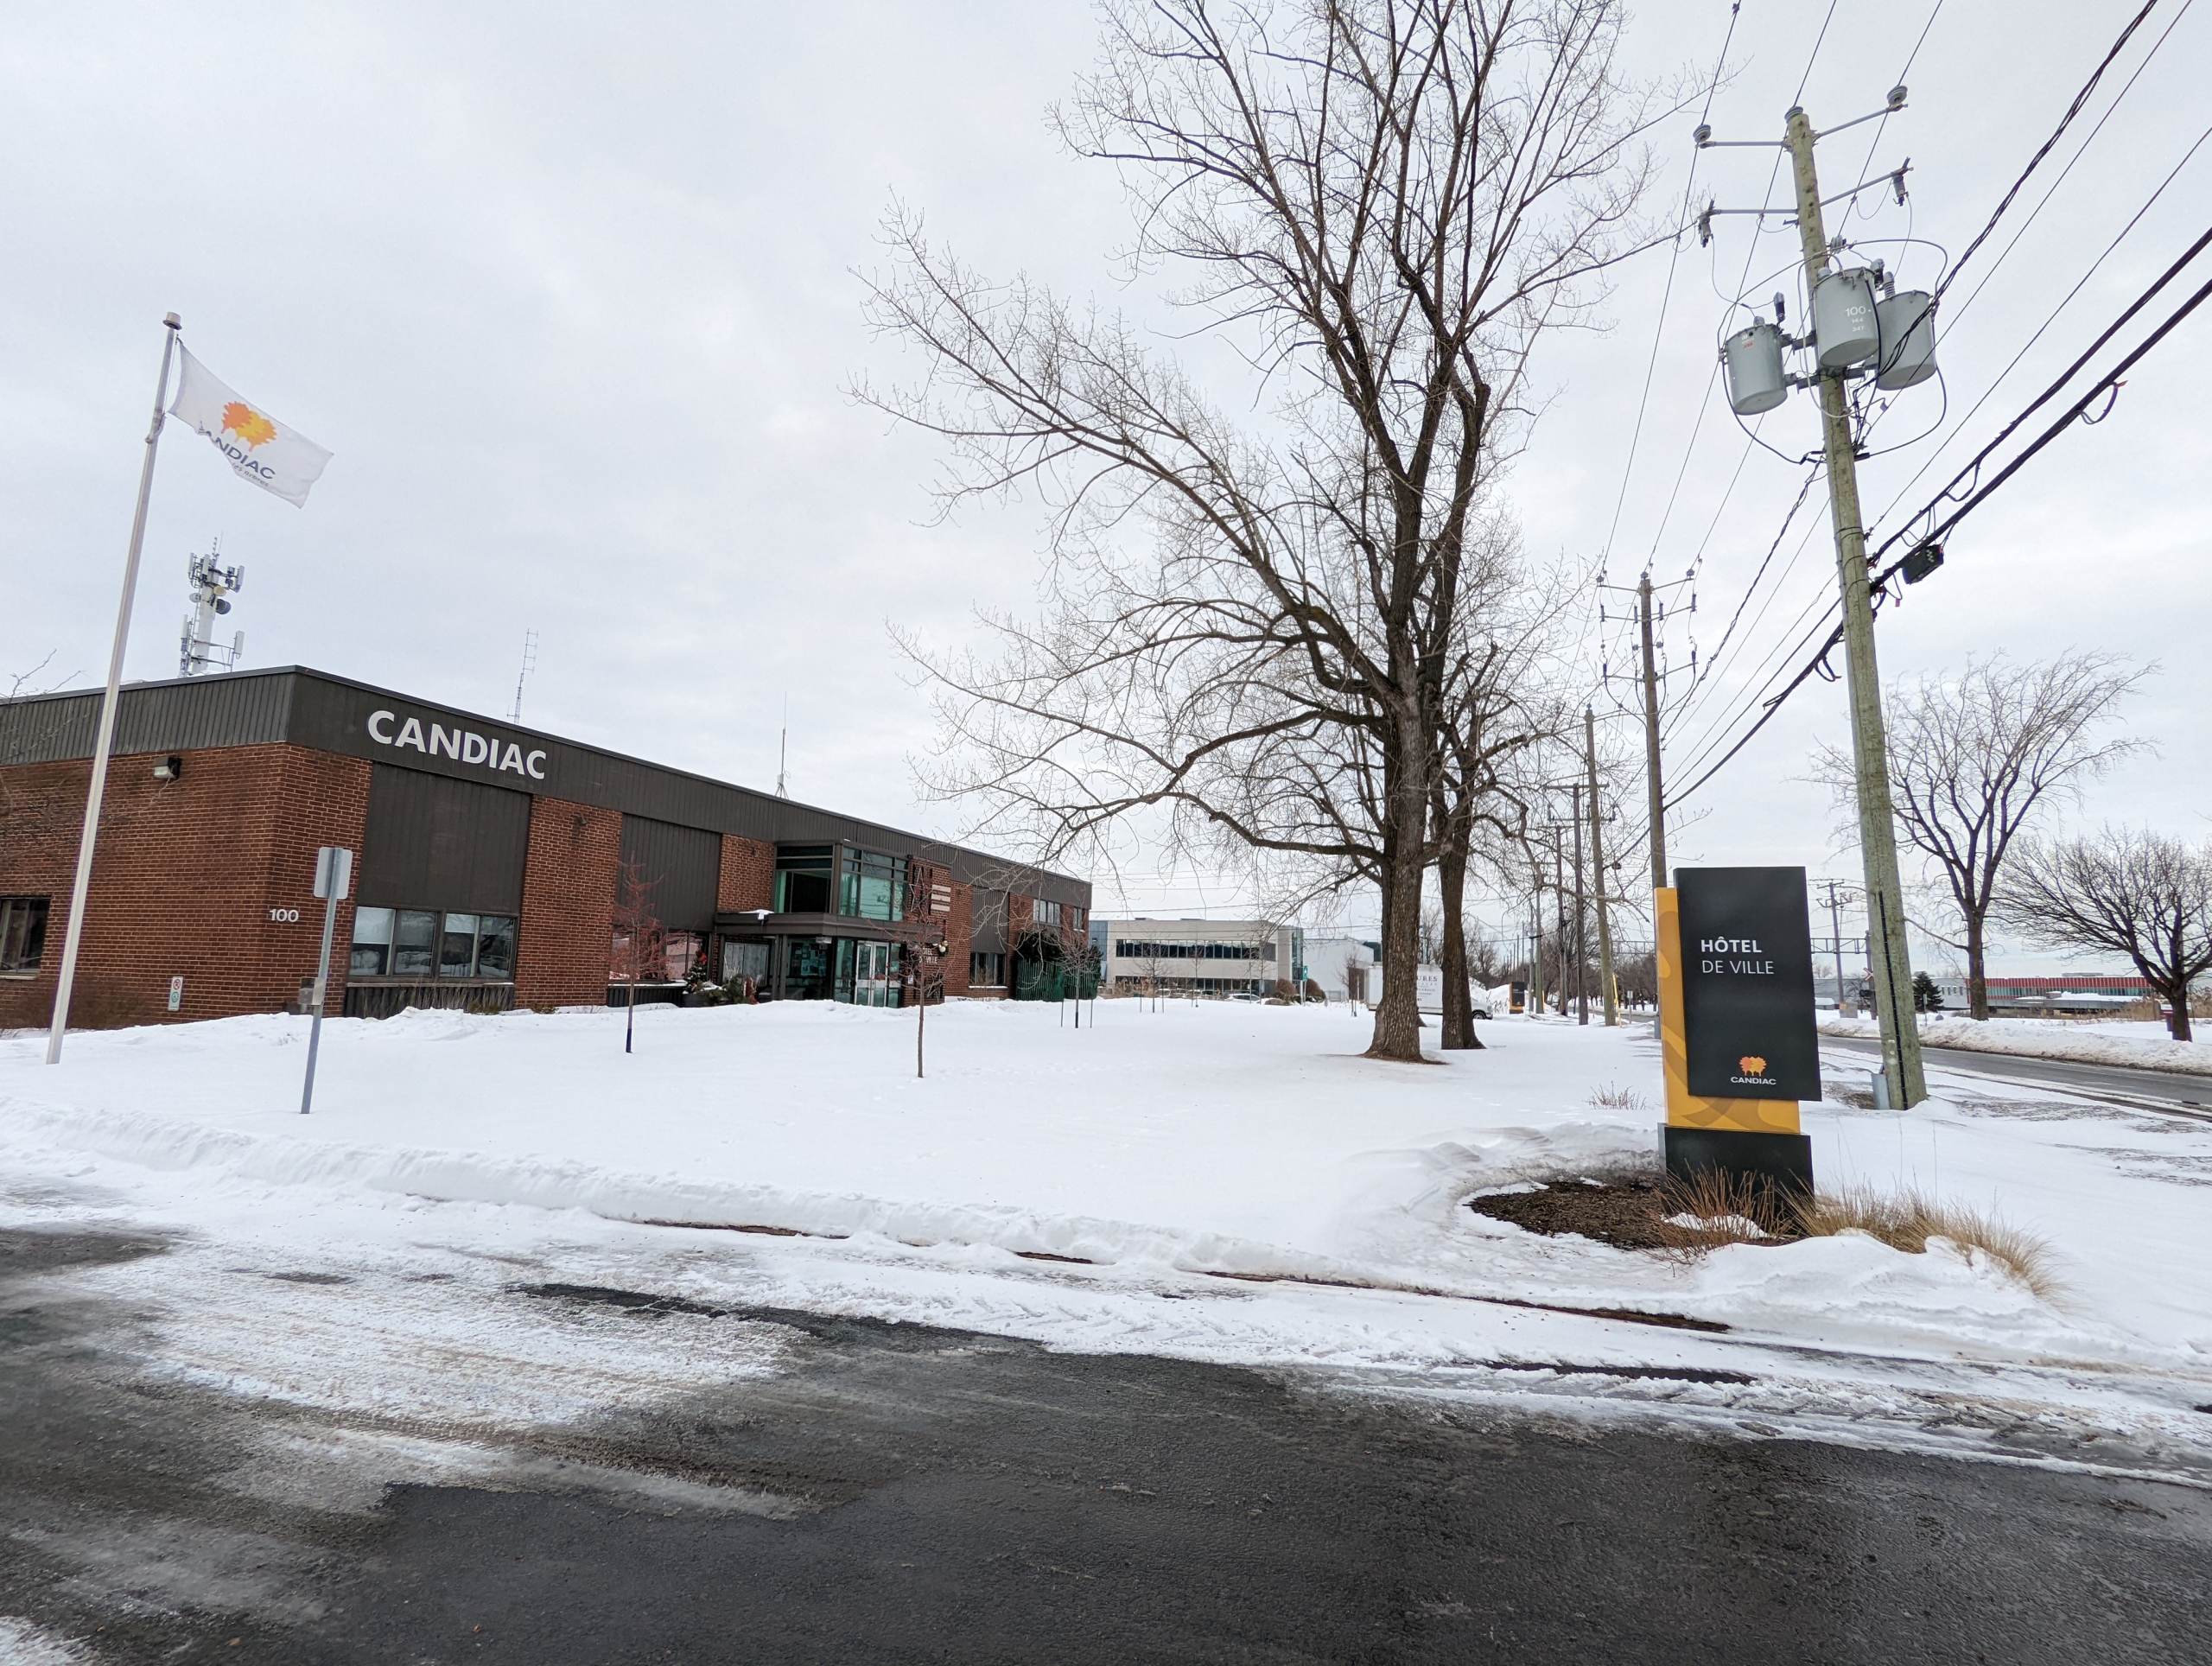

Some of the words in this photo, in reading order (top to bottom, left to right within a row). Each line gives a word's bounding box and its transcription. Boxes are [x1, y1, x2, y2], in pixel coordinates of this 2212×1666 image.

[1844, 305, 1866, 317] 100
[199, 422, 276, 480] NDIAC
[244, 469, 270, 486] arbres
[367, 709, 547, 779] CANDIAC
[269, 908, 300, 923] 100
[1700, 936, 1763, 953] HÔTEL
[1701, 959, 1725, 974] DE
[1729, 960, 1775, 975] VILLE
[1730, 1076, 1777, 1085] CANDIAC
